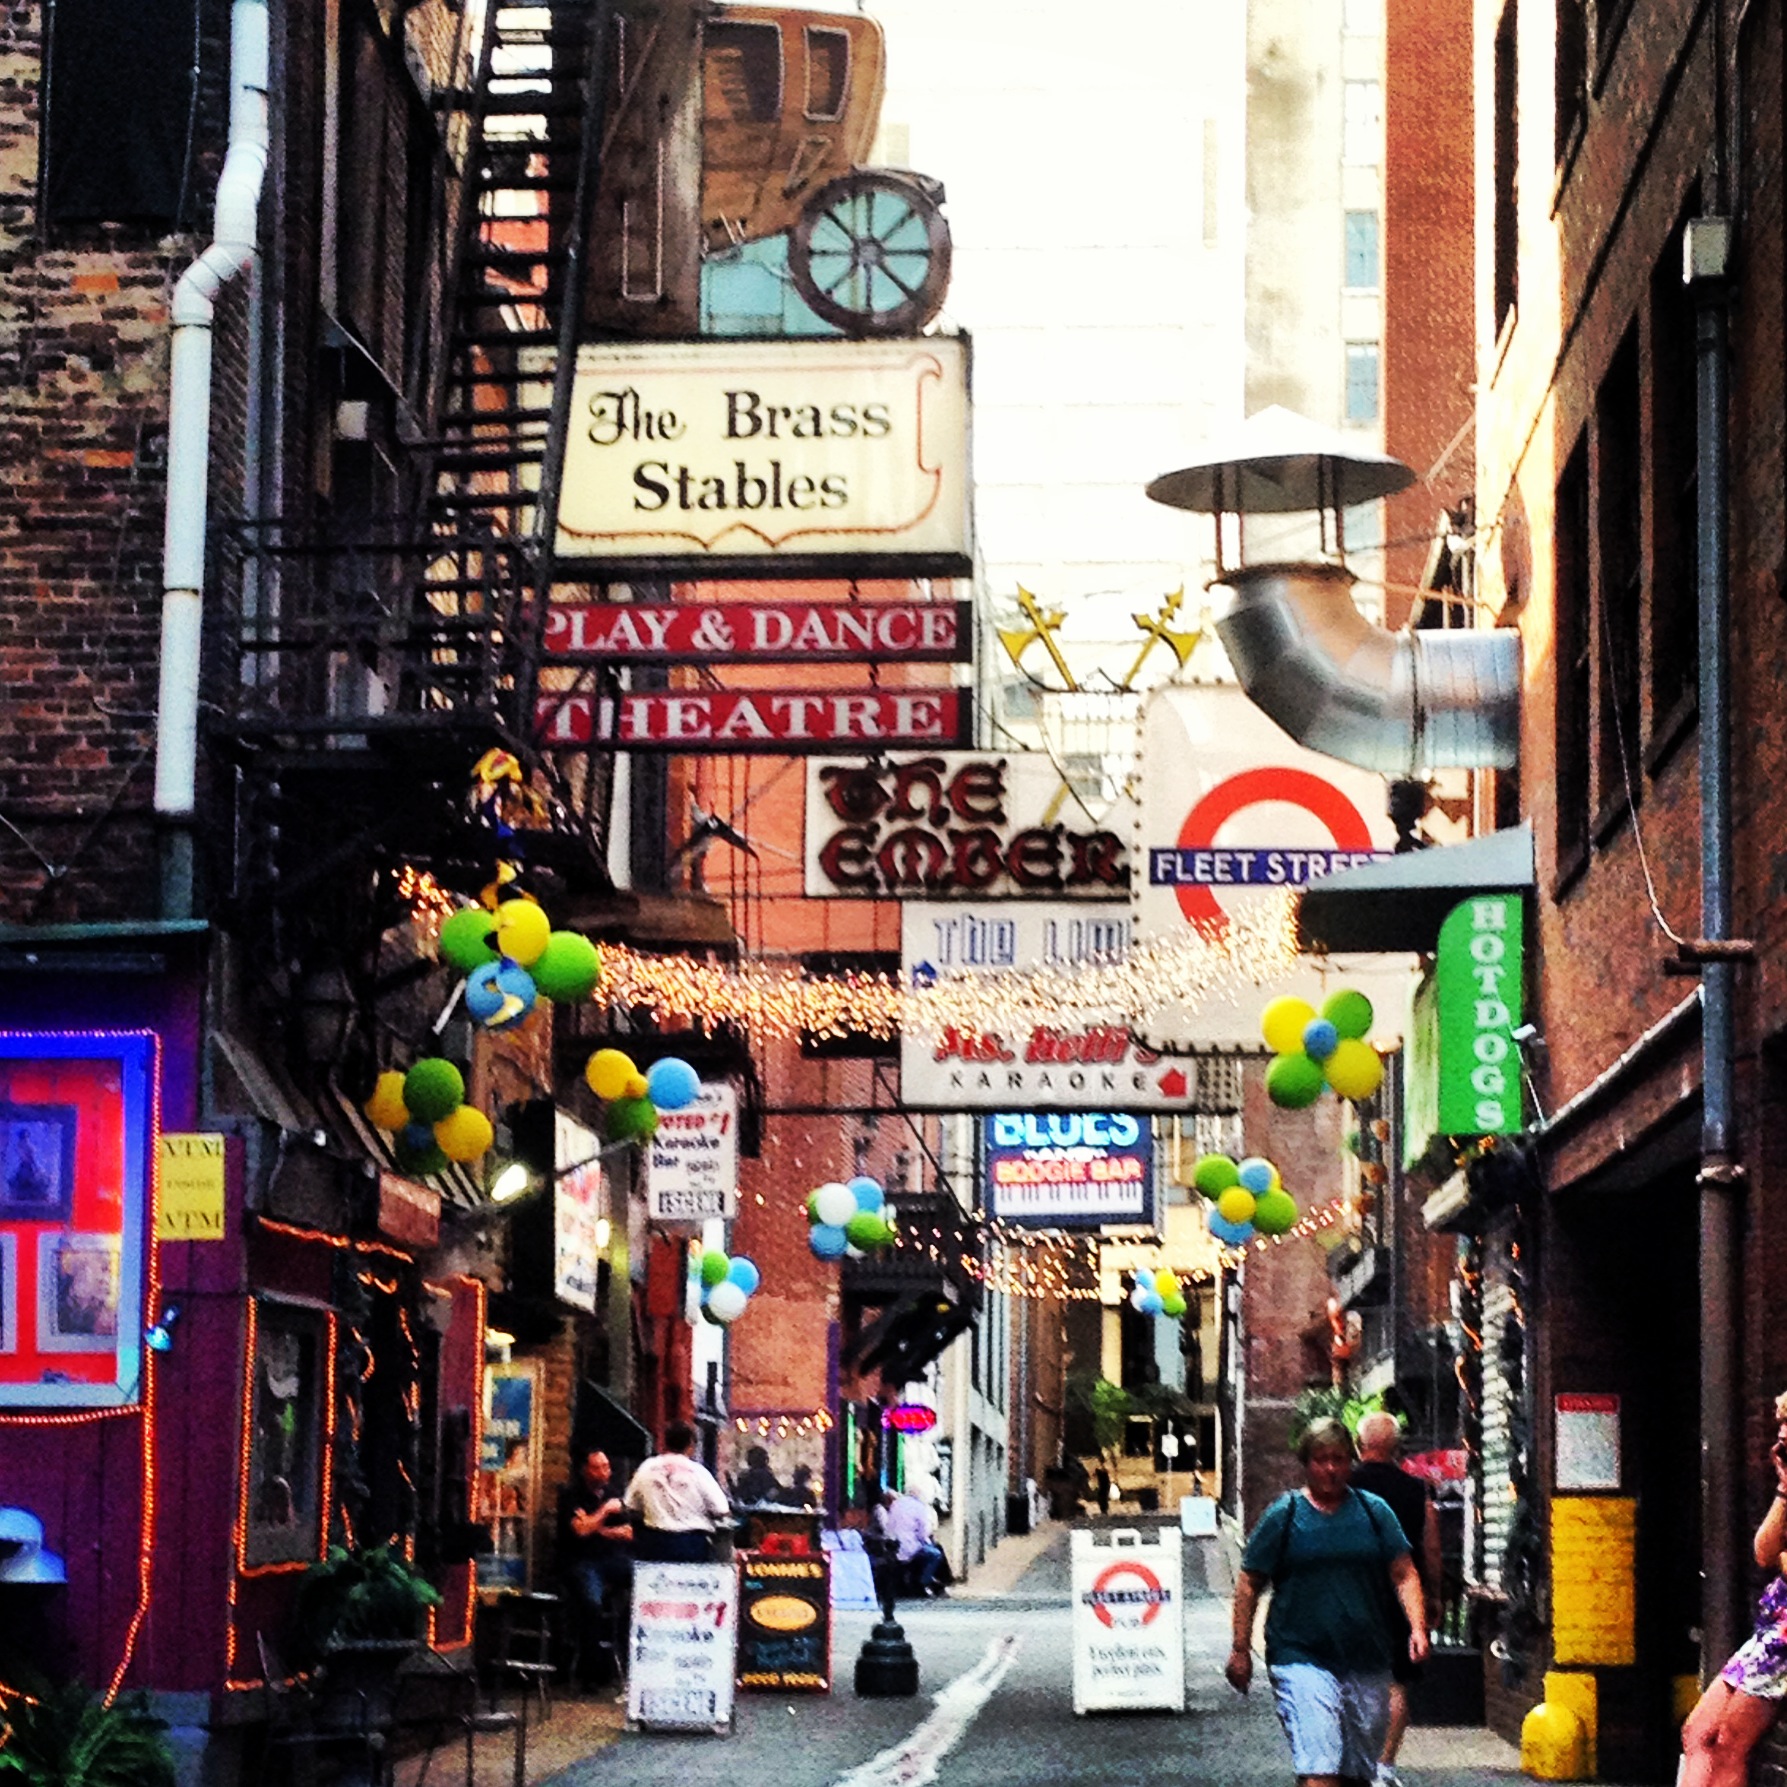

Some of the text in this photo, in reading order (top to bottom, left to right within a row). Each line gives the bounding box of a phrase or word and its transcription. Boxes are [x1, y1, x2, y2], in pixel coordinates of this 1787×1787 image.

[588, 386, 892, 445] The Brass
[632, 460, 849, 511] Stables
[691, 609, 736, 652] &
[748, 608, 958, 652] DANCE
[536, 694, 943, 740] THEATRE
[1156, 852, 1392, 883] FLEET STRE
[949, 1070, 1148, 1091] KARAOKE
[994, 1113, 1140, 1147] BLUES
[995, 1156, 1144, 1184] BOOGIE BAR
